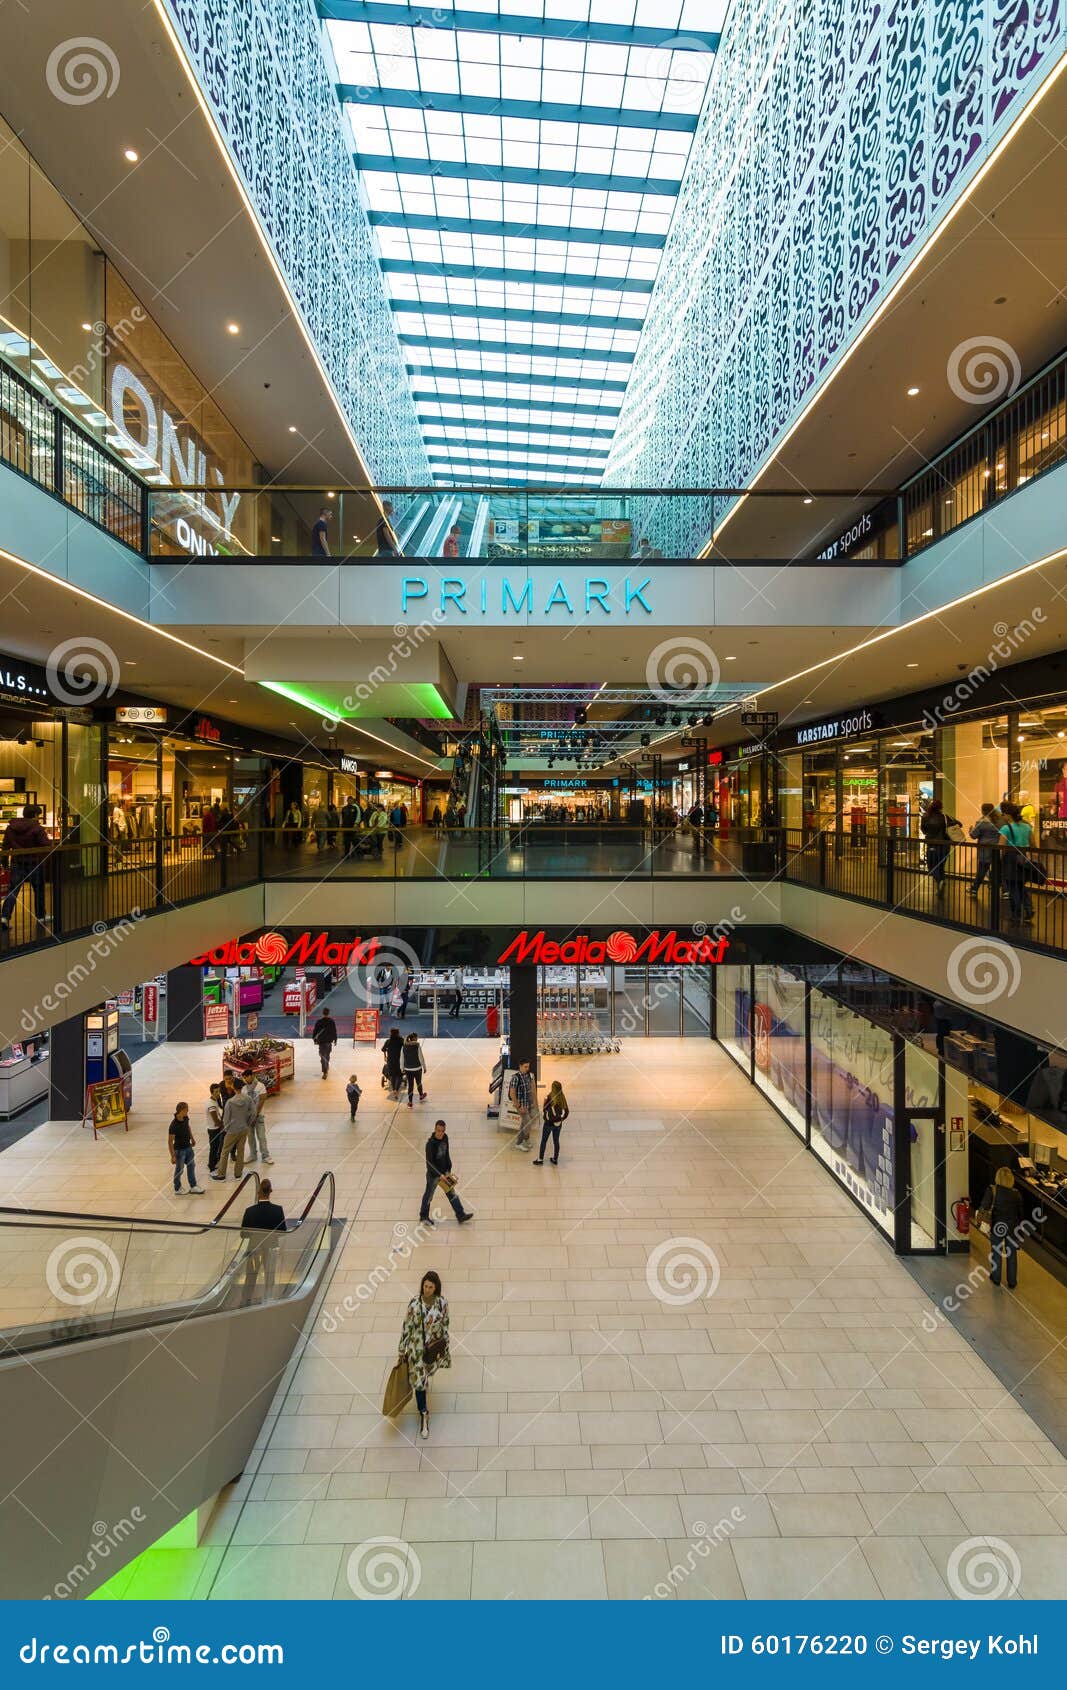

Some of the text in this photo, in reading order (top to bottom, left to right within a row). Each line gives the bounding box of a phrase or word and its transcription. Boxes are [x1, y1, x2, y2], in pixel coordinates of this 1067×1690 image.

[111, 364, 241, 543] ONLY
[840, 513, 872, 553] sports
[402, 577, 653, 614] PRIMARK
[797, 709, 872, 745] KARSTADT sports
[341, 758, 358, 773] MANGO
[829, 778, 878, 786] SEAKERS
[544, 779, 587, 787] PRIMARK
[279, 932, 381, 965] Markt
[497, 931, 730, 963] Media Markt
